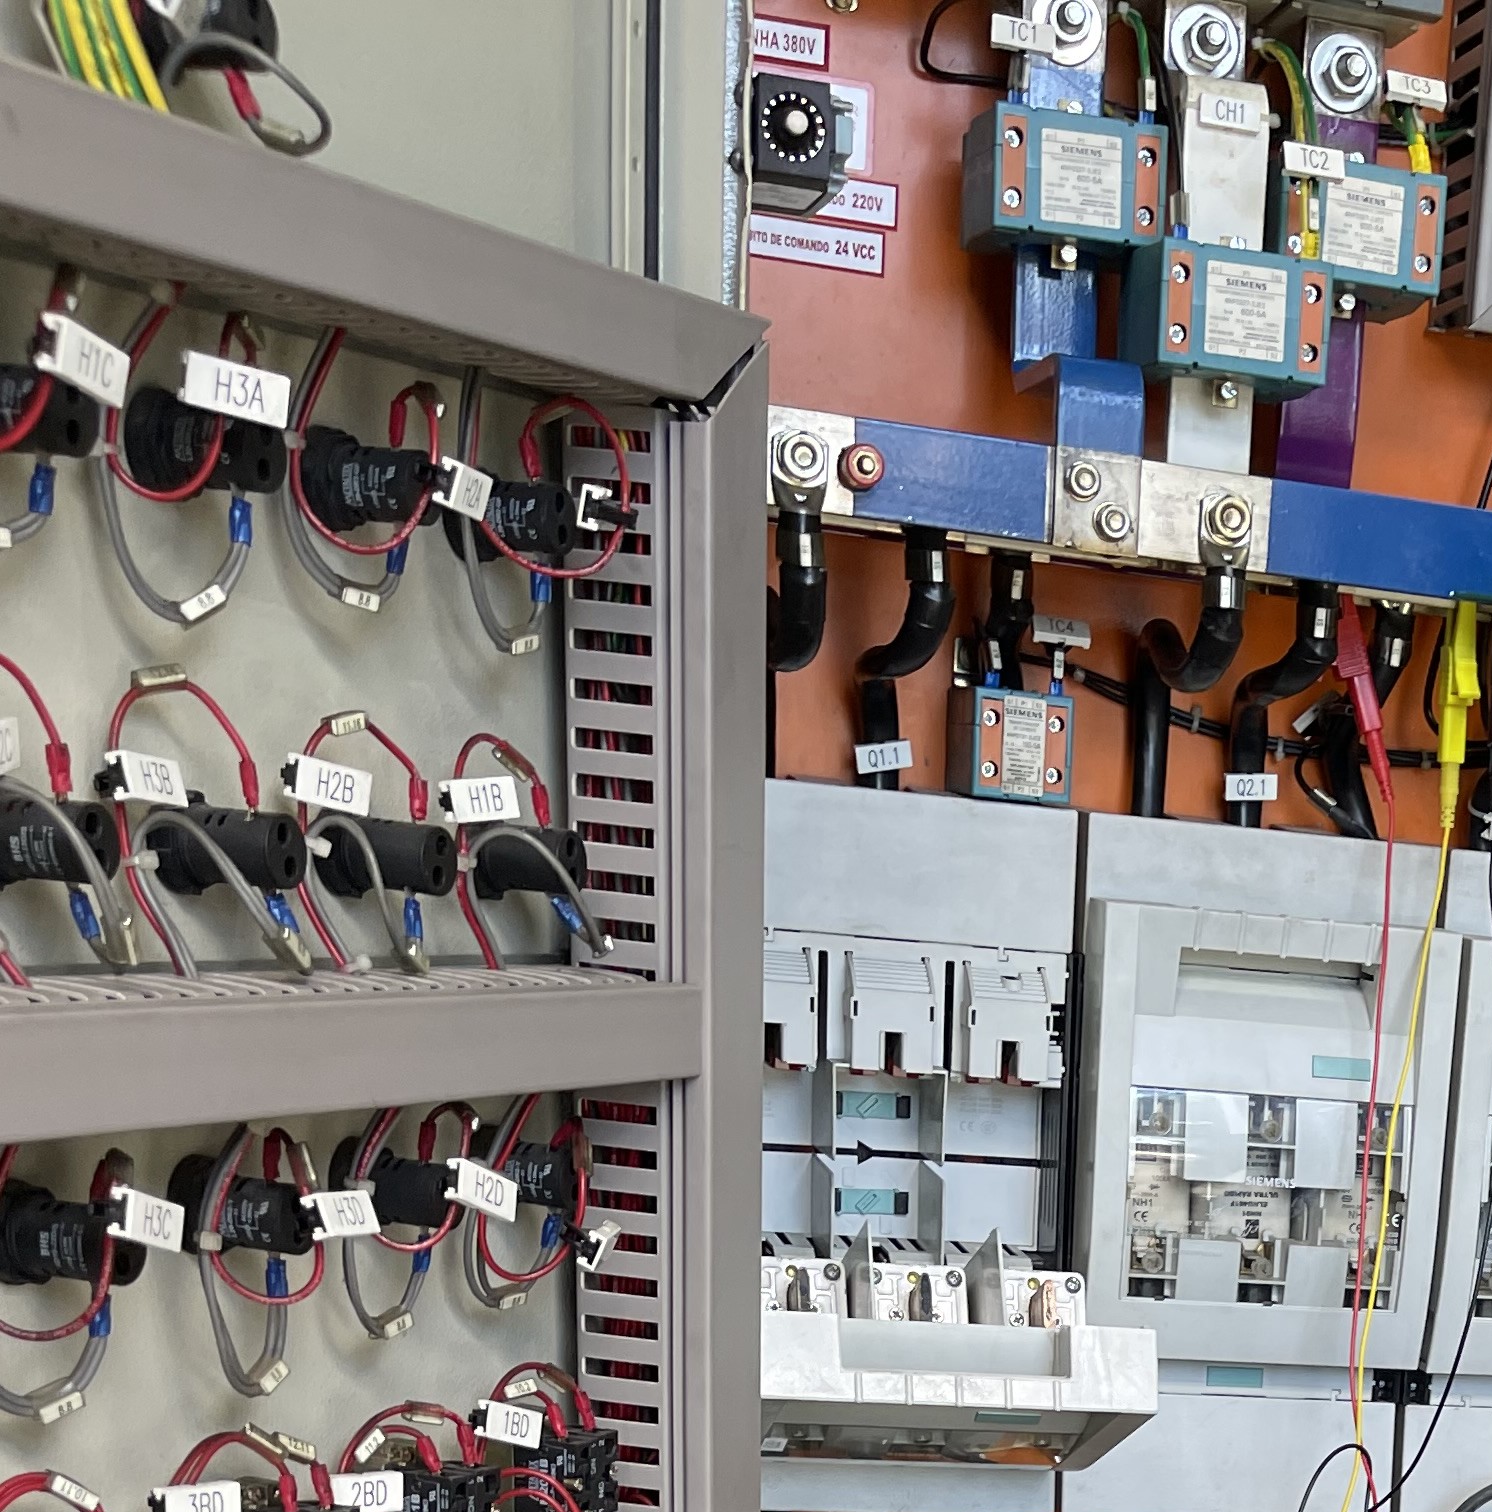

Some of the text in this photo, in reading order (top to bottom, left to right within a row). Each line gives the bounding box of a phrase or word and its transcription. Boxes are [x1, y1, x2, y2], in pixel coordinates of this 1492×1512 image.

[1009, 19, 1038, 44] TC1
[783, 33, 816, 56] 380V
[1402, 76, 1431, 95] TC3
[1215, 99, 1246, 124] CH1
[1060, 145, 1103, 159] SIEMENS
[1300, 147, 1330, 171] TC2
[852, 192, 883, 213] 220V
[1346, 191, 1387, 207] SIEMENS
[771, 233, 876, 260] DE COMANDO 24 VCC
[1226, 277, 1267, 292] SIEMENS
[78, 339, 115, 389] H1C
[215, 367, 265, 413] H3A
[465, 475, 484, 508] H2A
[1048, 618, 1075, 634] TC4
[1005, 707, 1044, 719] SIEMENS
[868, 746, 899, 768] Q1.1
[140, 760, 174, 796] H3B
[317, 767, 355, 804] H2B
[1237, 778, 1266, 797] Q2.1
[468, 783, 505, 814] H1B
[475, 1170, 504, 1207] H2D
[1246, 1176, 1296, 1189] SIEMENS
[335, 1197, 365, 1226] H3D
[1132, 1198, 1153, 1208] NH1
[143, 1205, 172, 1240] H3C
[503, 1410, 530, 1438] 1BD
[351, 1480, 387, 1507] 2BD
